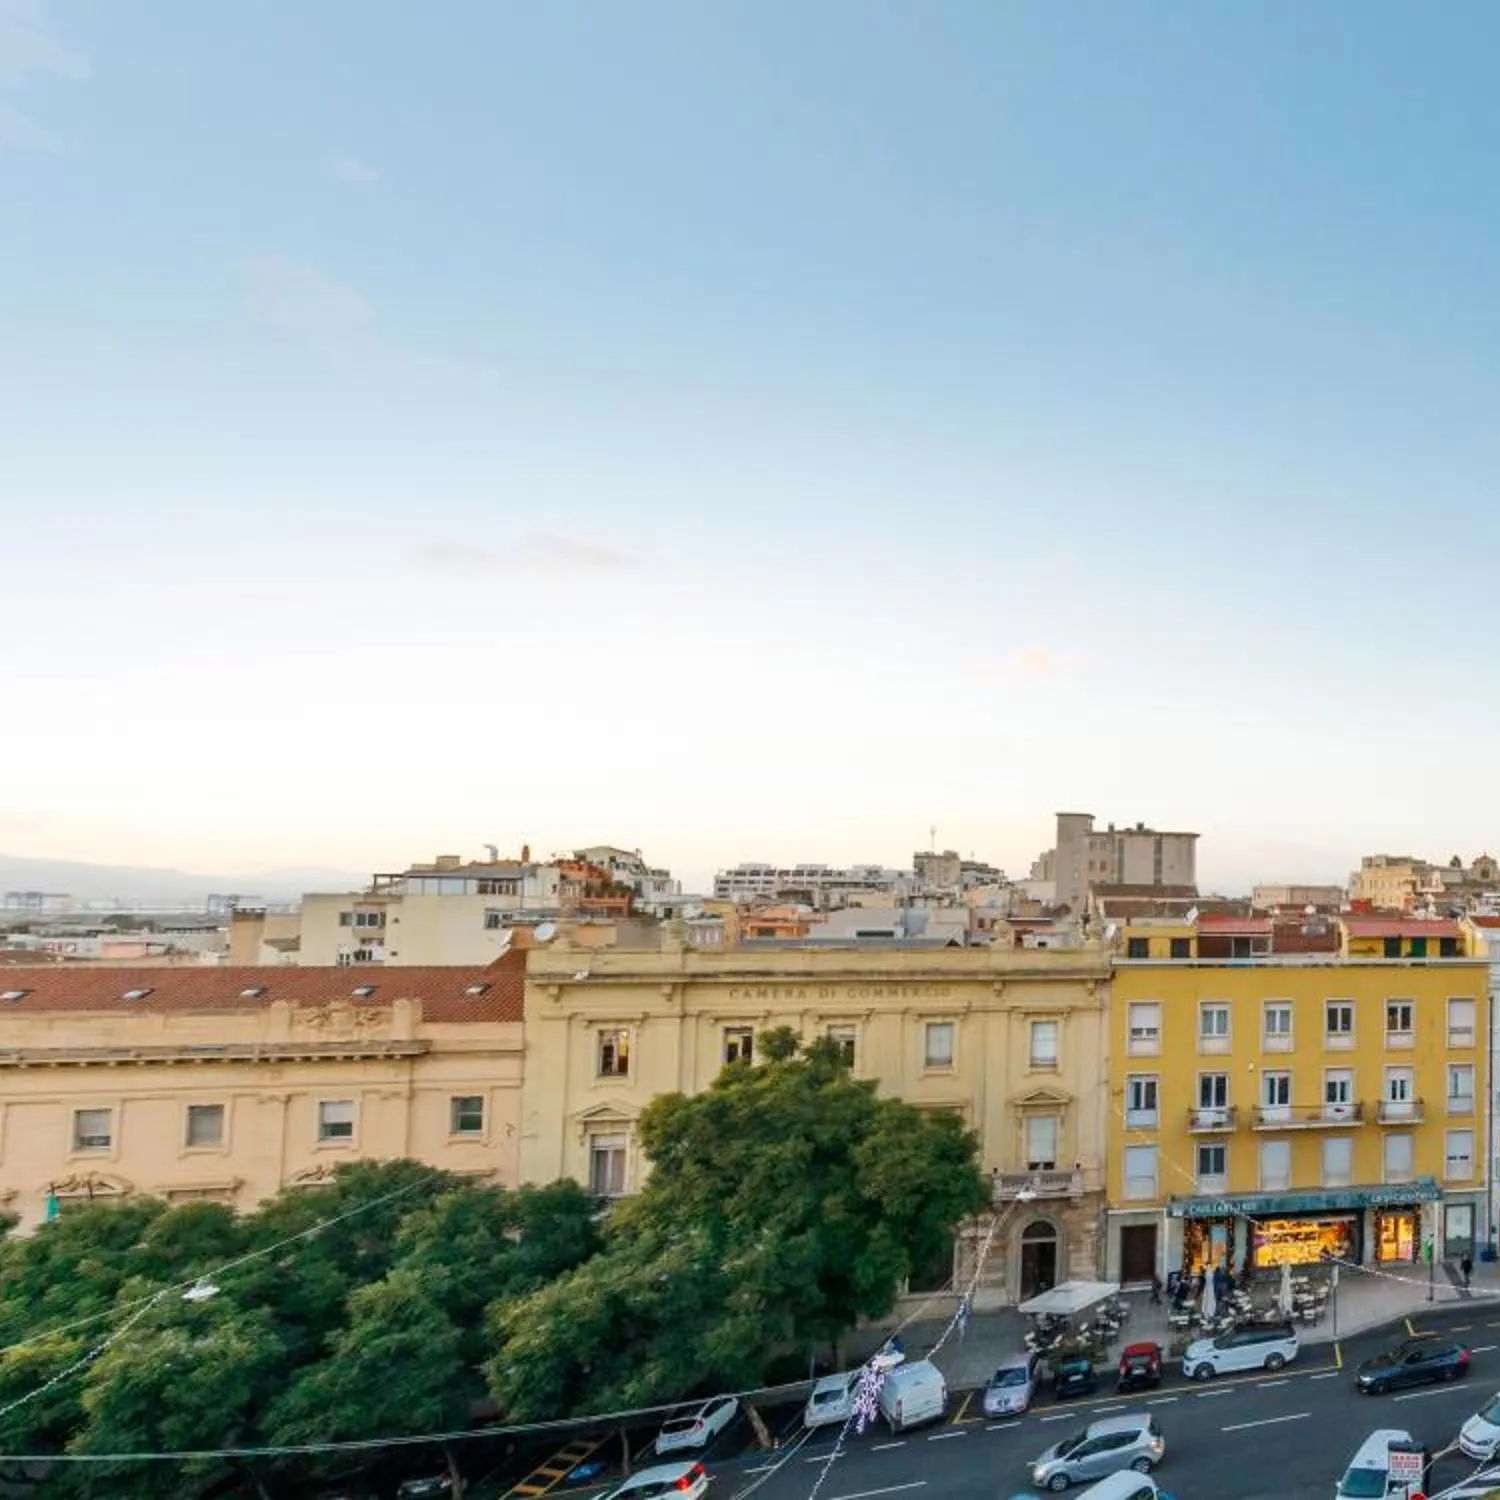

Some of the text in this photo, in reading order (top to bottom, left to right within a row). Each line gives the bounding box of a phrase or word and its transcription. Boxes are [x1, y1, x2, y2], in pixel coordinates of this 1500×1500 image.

[729, 986, 952, 1000] CAMERA DI COMMERCIO
